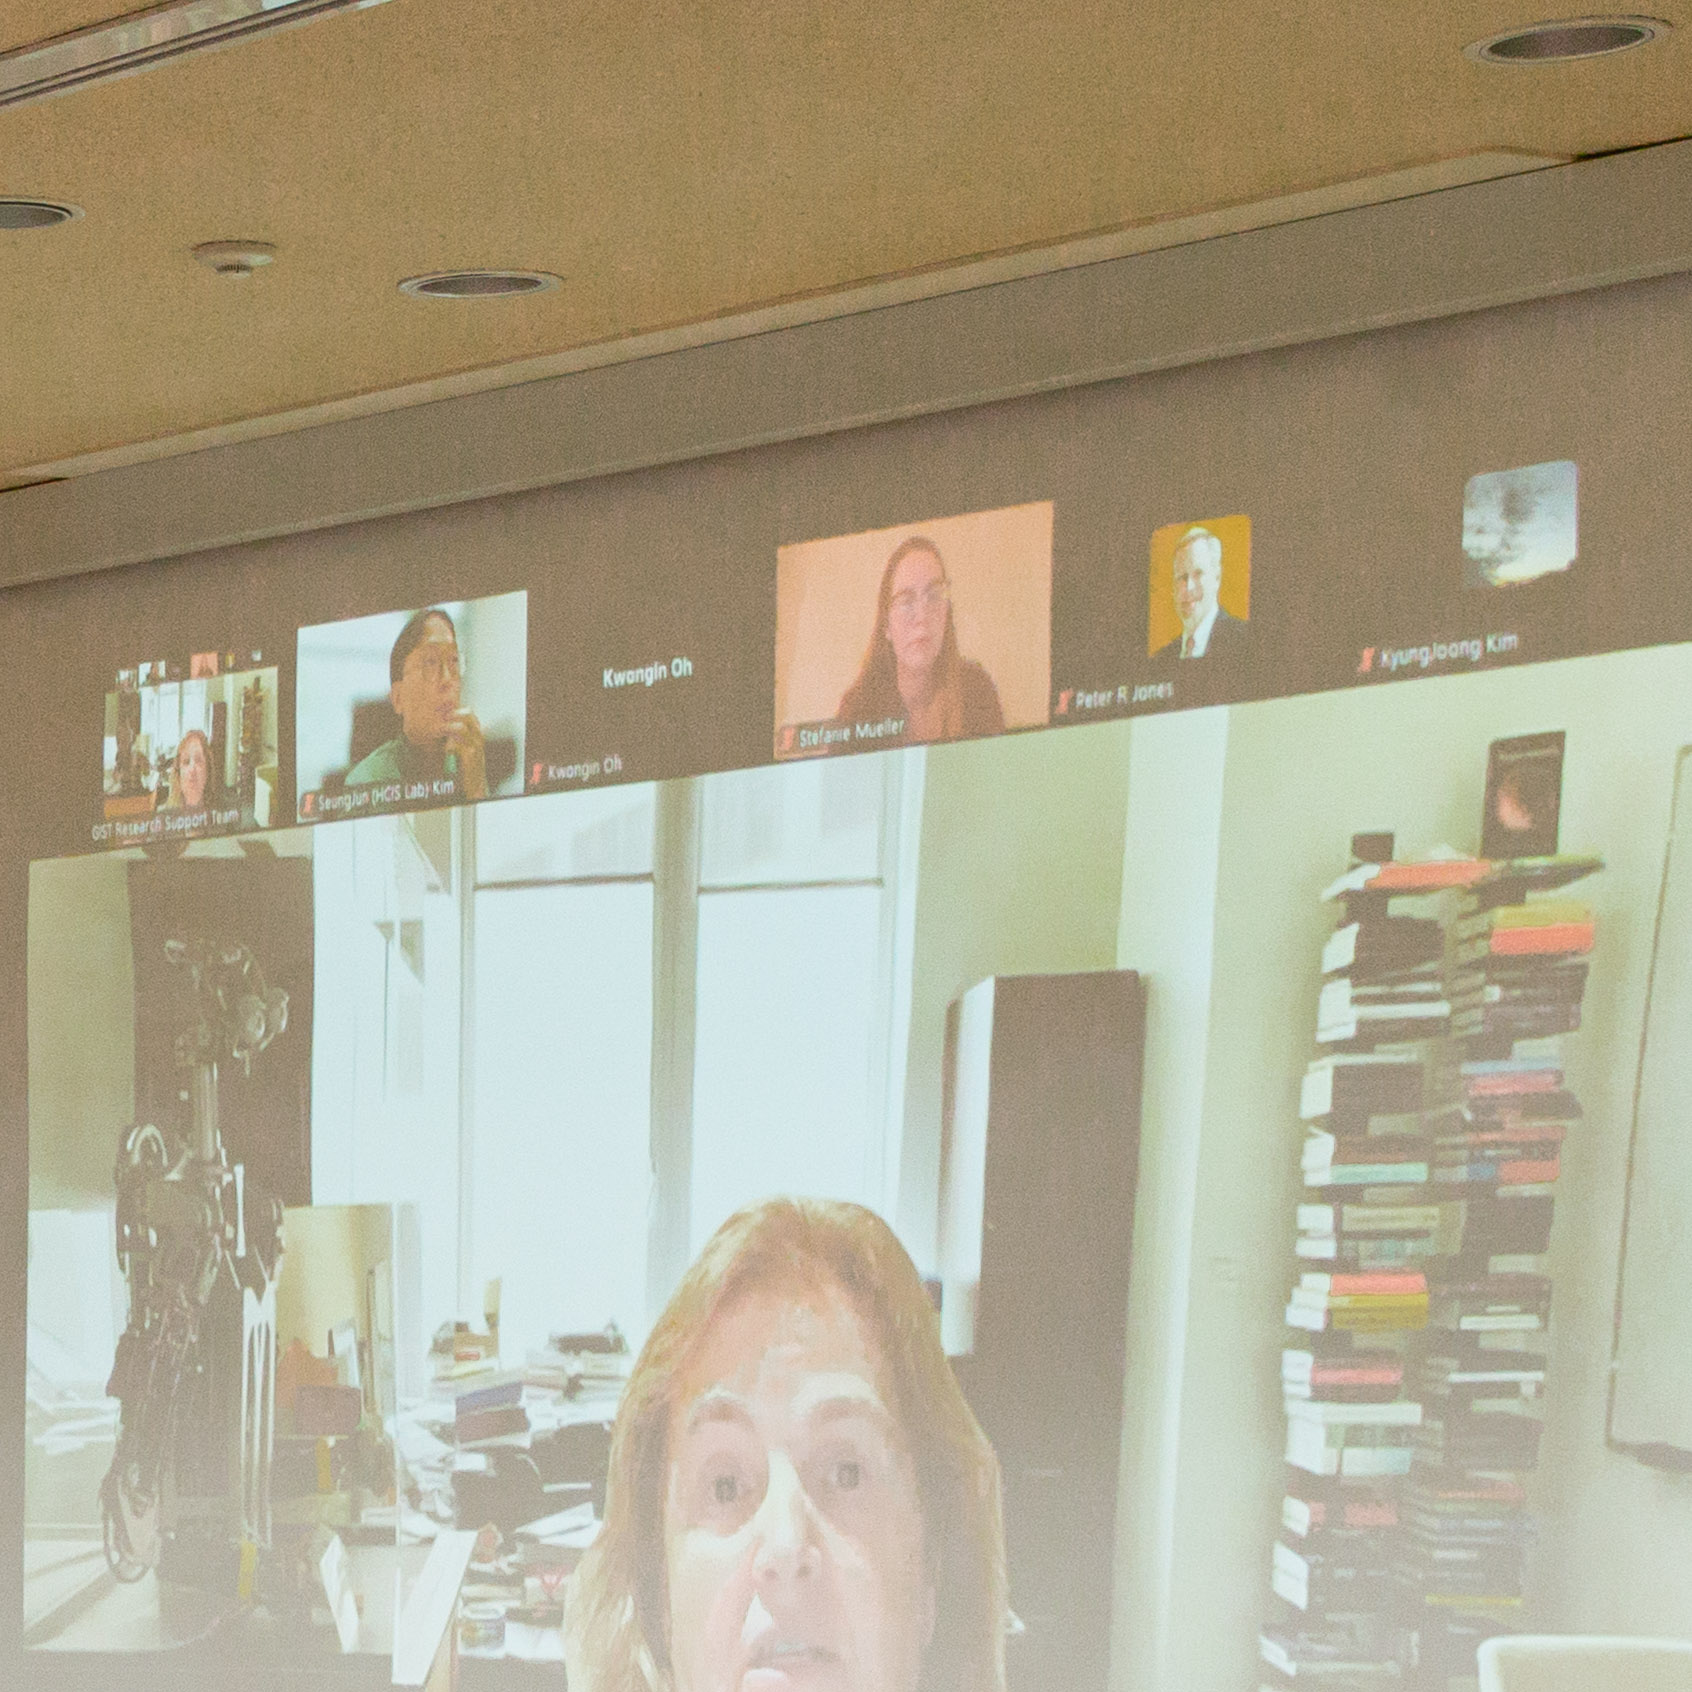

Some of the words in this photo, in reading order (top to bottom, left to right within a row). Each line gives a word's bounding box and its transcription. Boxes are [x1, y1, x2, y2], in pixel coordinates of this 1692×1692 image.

[1487, 632, 1518, 653] Kim
[671, 657, 693, 678] Oh
[1076, 689, 1113, 709] Peter
[800, 726, 851, 747] Stefanie
[856, 717, 904, 738] Mueller
[603, 753, 623, 775] Oh
[433, 780, 454, 795] Kim
[92, 824, 112, 841] GIST
[116, 816, 162, 837] Research
[166, 811, 208, 832] Support
[212, 810, 240, 825] Team
